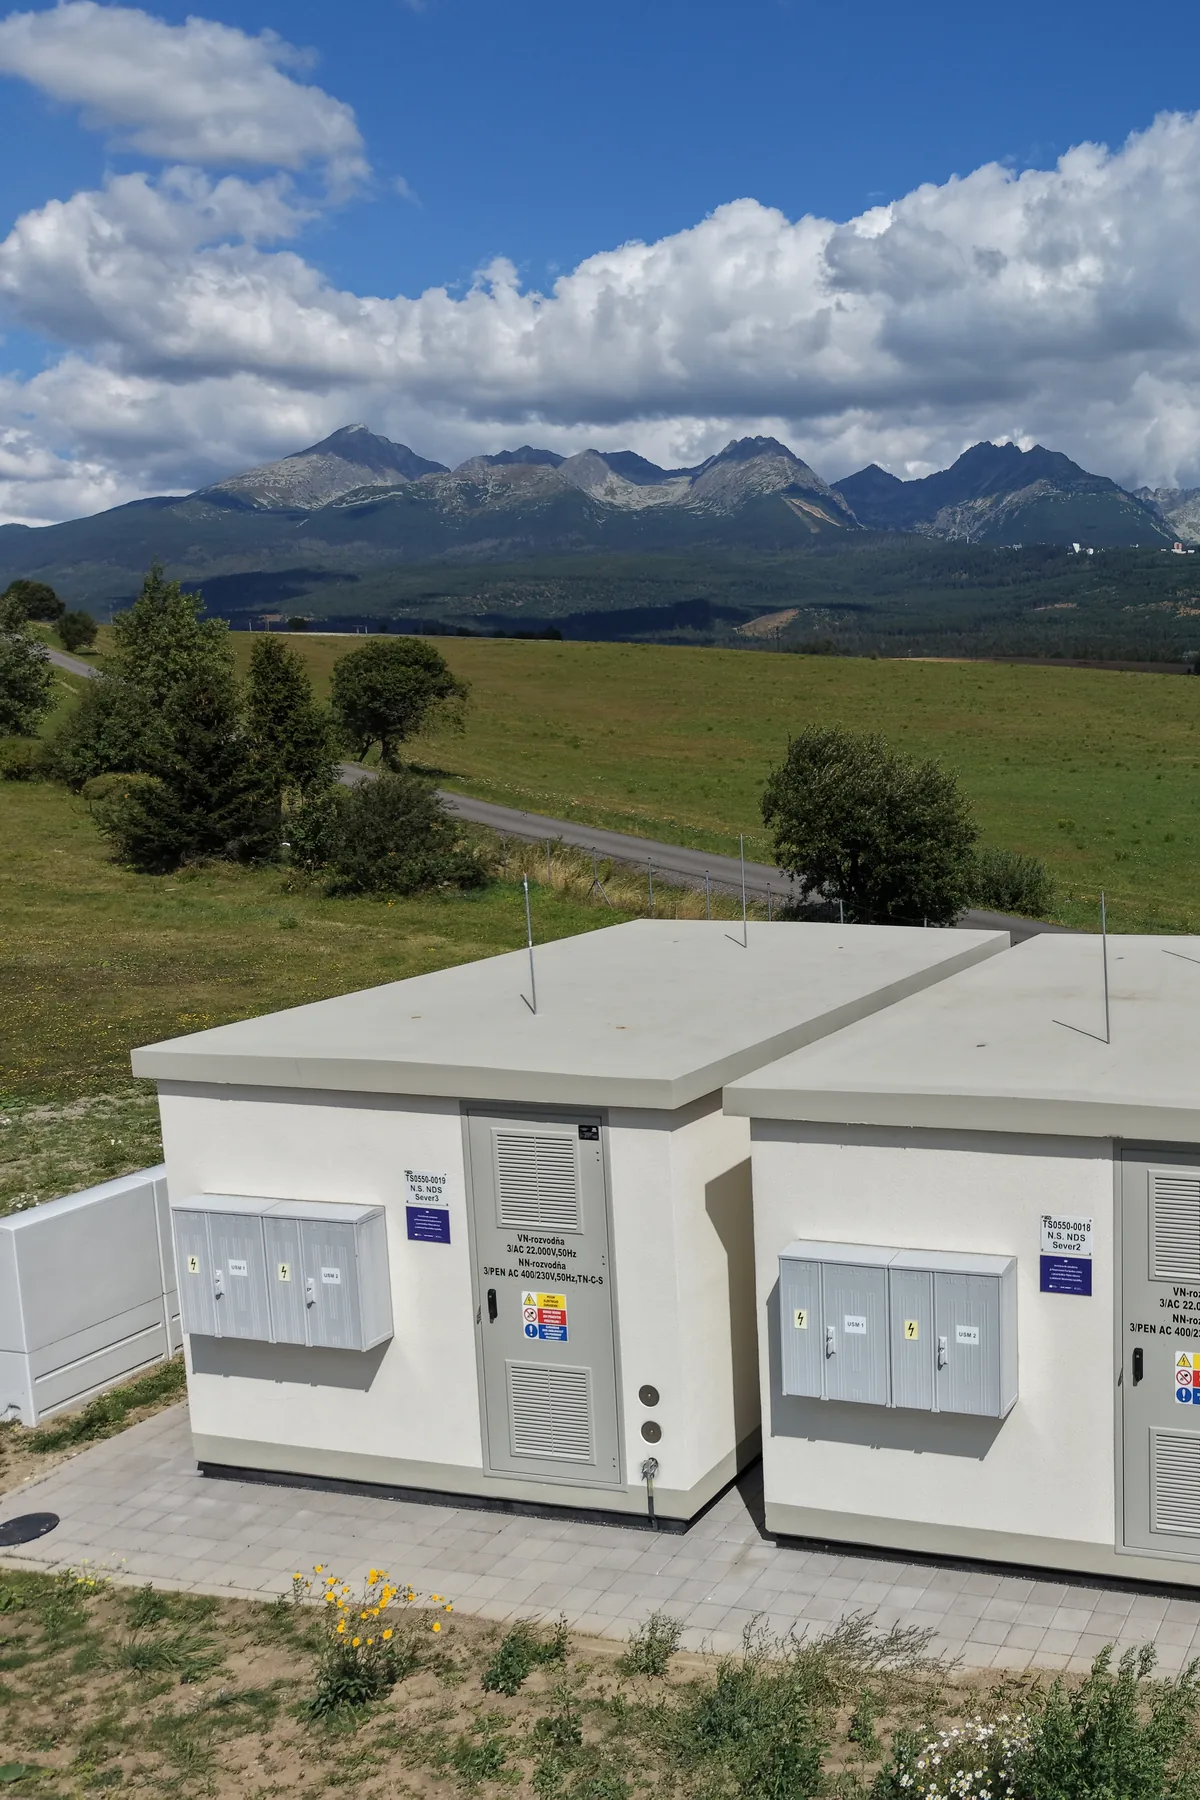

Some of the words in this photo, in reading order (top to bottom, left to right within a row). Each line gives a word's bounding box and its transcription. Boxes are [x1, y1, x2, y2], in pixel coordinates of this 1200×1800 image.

[405, 1174, 446, 1184] TS0550-0019
[410, 1184, 424, 1192] N.S.
[426, 1186, 442, 1194] NDS
[415, 1194, 439, 1202] Sever3
[1042, 1220, 1090, 1232] TS0550-0018
[517, 1234, 565, 1246] VN-rozvodňa
[1048, 1232, 1064, 1240] N.S.
[1066, 1234, 1086, 1242] NDS
[1052, 1242, 1080, 1250] Sever2
[526, 1246, 577, 1258] 22.000V,50Hz
[518, 1258, 566, 1270] NN-rozvodňa
[508, 1269, 519, 1278] AC
[1160, 1298, 1180, 1308] 3/AC
[1130, 1323, 1156, 1334] 3/PEN
[1159, 1326, 1172, 1335] AC
